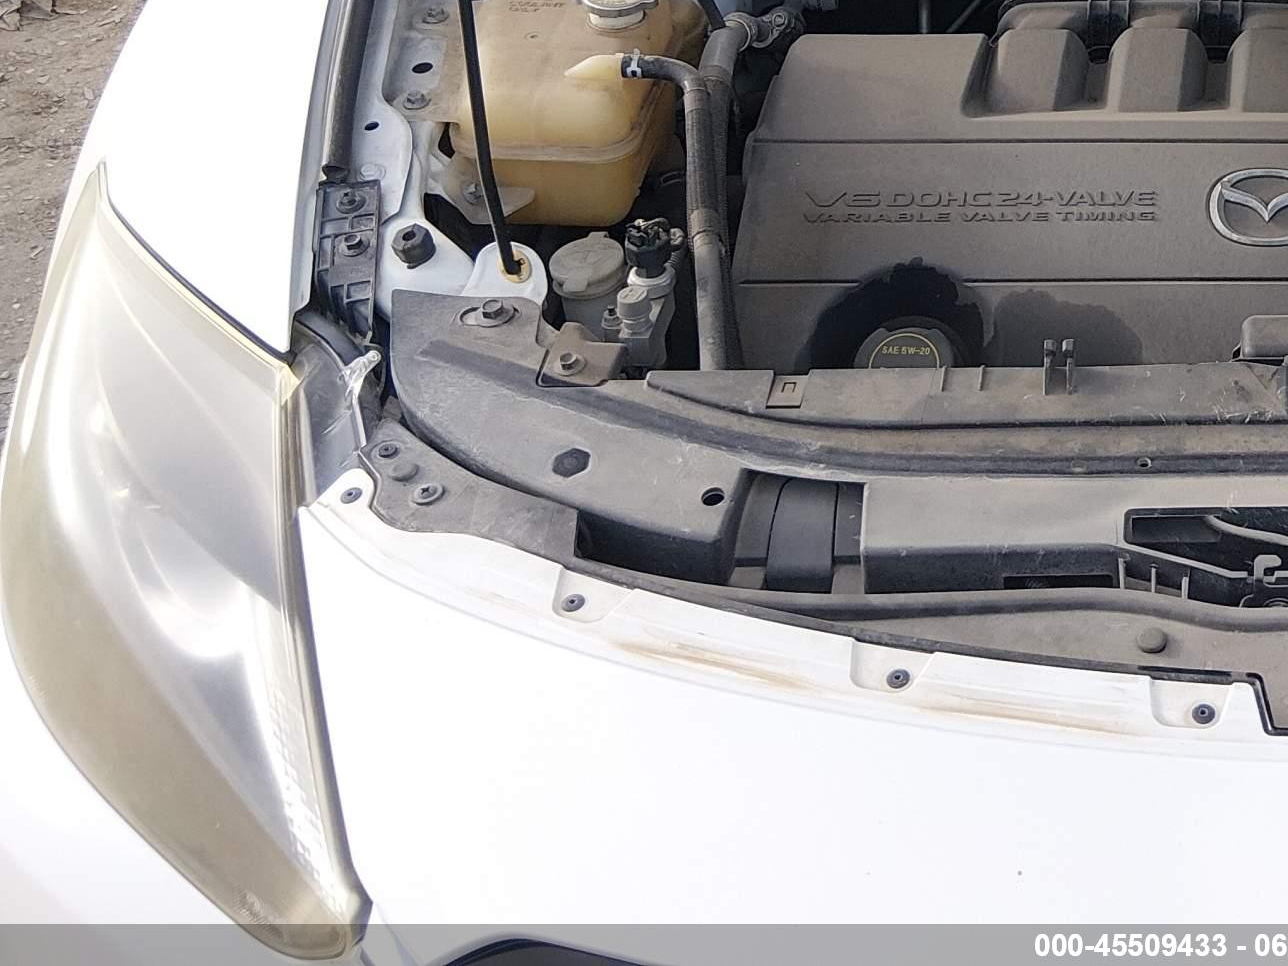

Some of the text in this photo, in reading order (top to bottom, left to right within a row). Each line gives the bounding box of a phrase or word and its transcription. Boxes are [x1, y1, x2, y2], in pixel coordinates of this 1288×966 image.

[804, 190, 1159, 208] V6 DOHC 24-VALVE
[803, 211, 1157, 223] VARIABLE VALVE TIMING
[881, 345, 931, 355] SAE 5W-20
